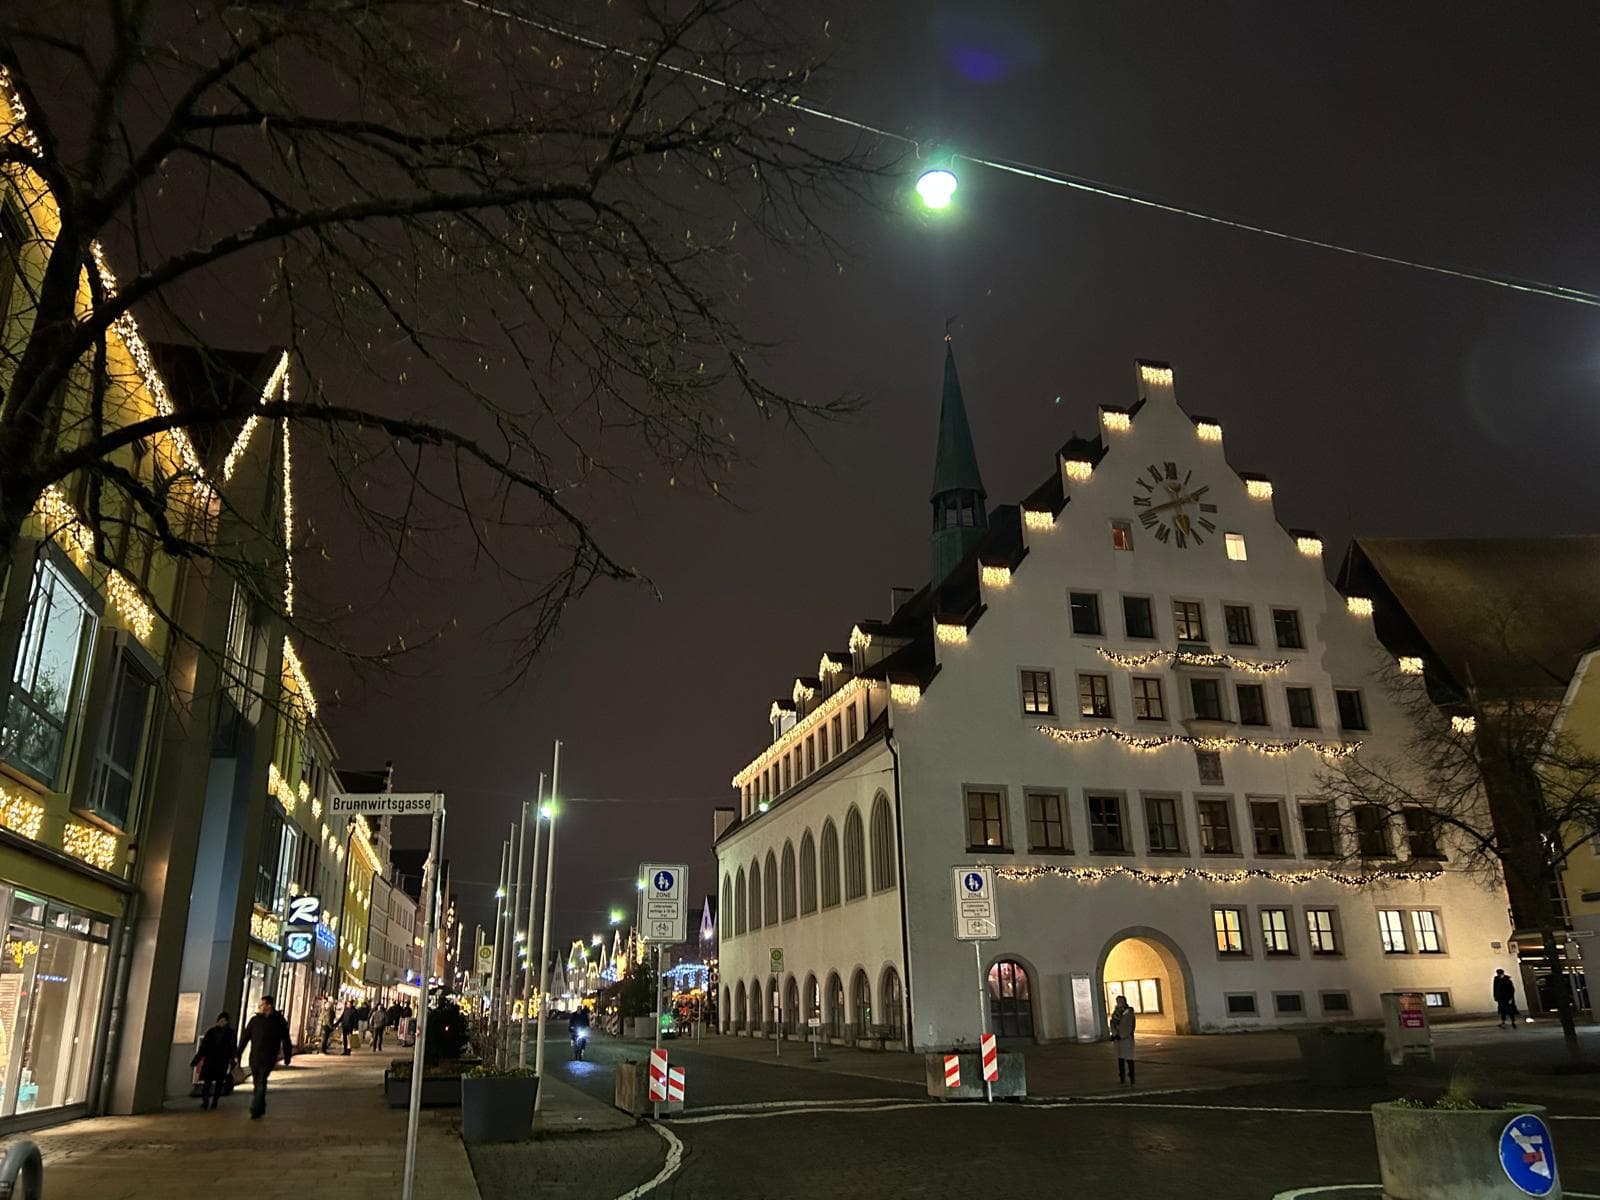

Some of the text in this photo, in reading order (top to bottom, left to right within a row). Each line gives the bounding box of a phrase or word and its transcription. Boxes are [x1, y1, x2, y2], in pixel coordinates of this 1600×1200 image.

[1184, 469, 1192, 485] I
[1135, 477, 1154, 493] X
[1133, 495, 1152, 507] IX
[333, 797, 431, 812] Brunnwirtsgasse
